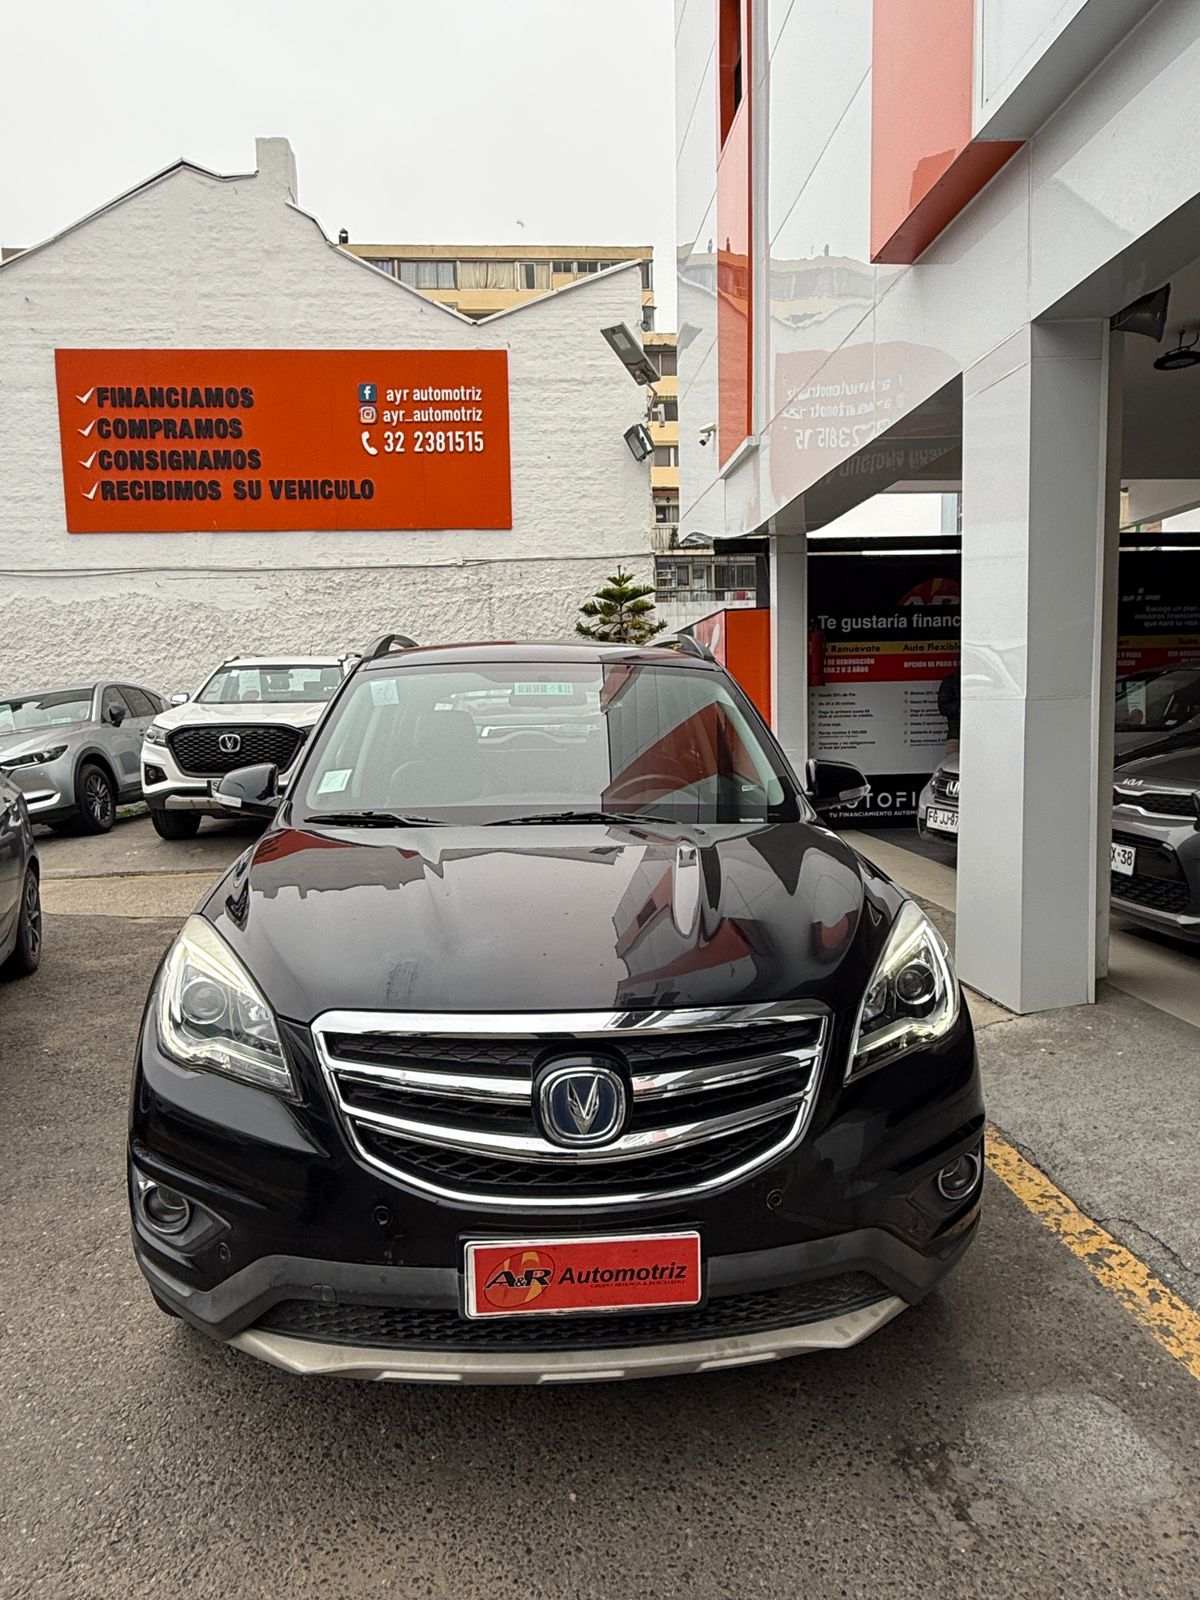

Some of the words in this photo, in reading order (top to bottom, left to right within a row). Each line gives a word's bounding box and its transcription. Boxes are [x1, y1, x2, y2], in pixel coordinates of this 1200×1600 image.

[97, 386, 255, 408] FINANCIAMOS
[386, 388, 410, 405] ayr
[412, 385, 483, 402] automotriz
[383, 406, 483, 426] ayr_automotriz
[97, 418, 243, 440] COMPRAMOS
[383, 430, 405, 454] 32
[413, 430, 485, 453] 2381515
[98, 449, 262, 471] CONSIGNAMOS
[101, 480, 222, 501] RECIBIMOS
[233, 479, 262, 501] SU
[269, 478, 375, 500] VEHICULO
[810, 615, 837, 630] Te
[841, 613, 908, 633] gustaría
[903, 644, 924, 652] Auto
[1122, 778, 1144, 786] KIA
[828, 811, 838, 819] TU
[838, 809, 892, 818] FINANCIAMIENTO
[558, 1261, 687, 1285] Automotriz
